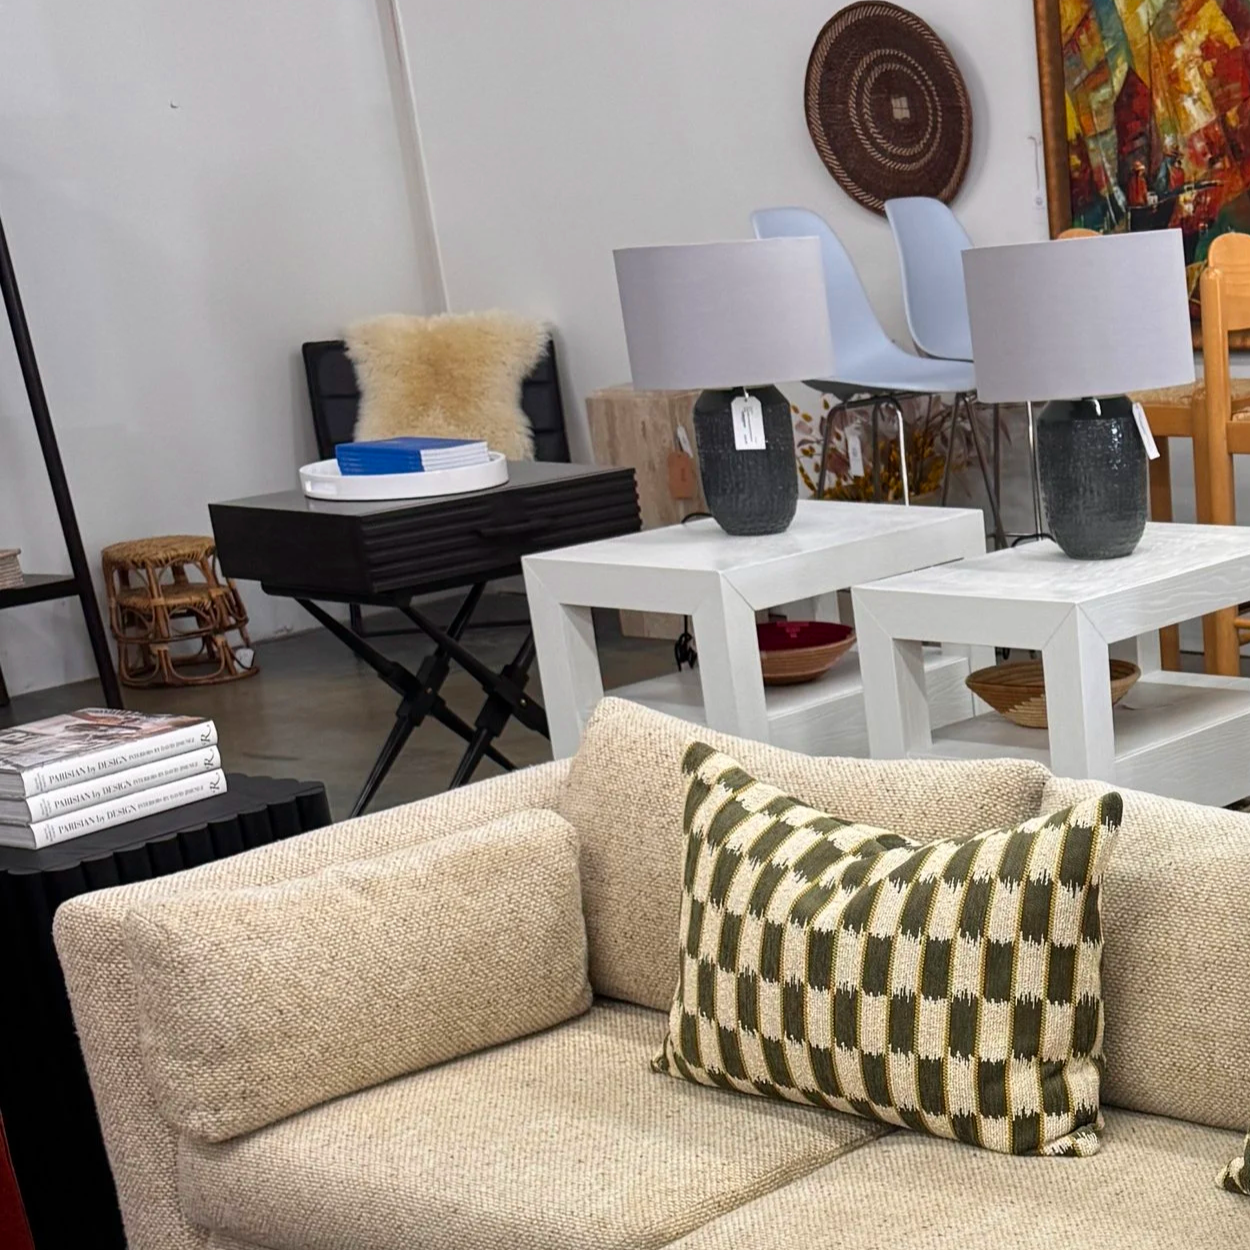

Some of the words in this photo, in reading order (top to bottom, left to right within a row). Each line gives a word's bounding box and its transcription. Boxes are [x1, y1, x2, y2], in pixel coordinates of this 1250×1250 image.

[49, 767, 86, 784] PARISIAN
[98, 756, 127, 770] DESIGN
[54, 792, 91, 809] PARISIAN
[92, 790, 101, 798] by
[102, 780, 132, 795] DESIGN
[58, 816, 95, 834] PARISIAN
[106, 804, 137, 820] DESIGN
